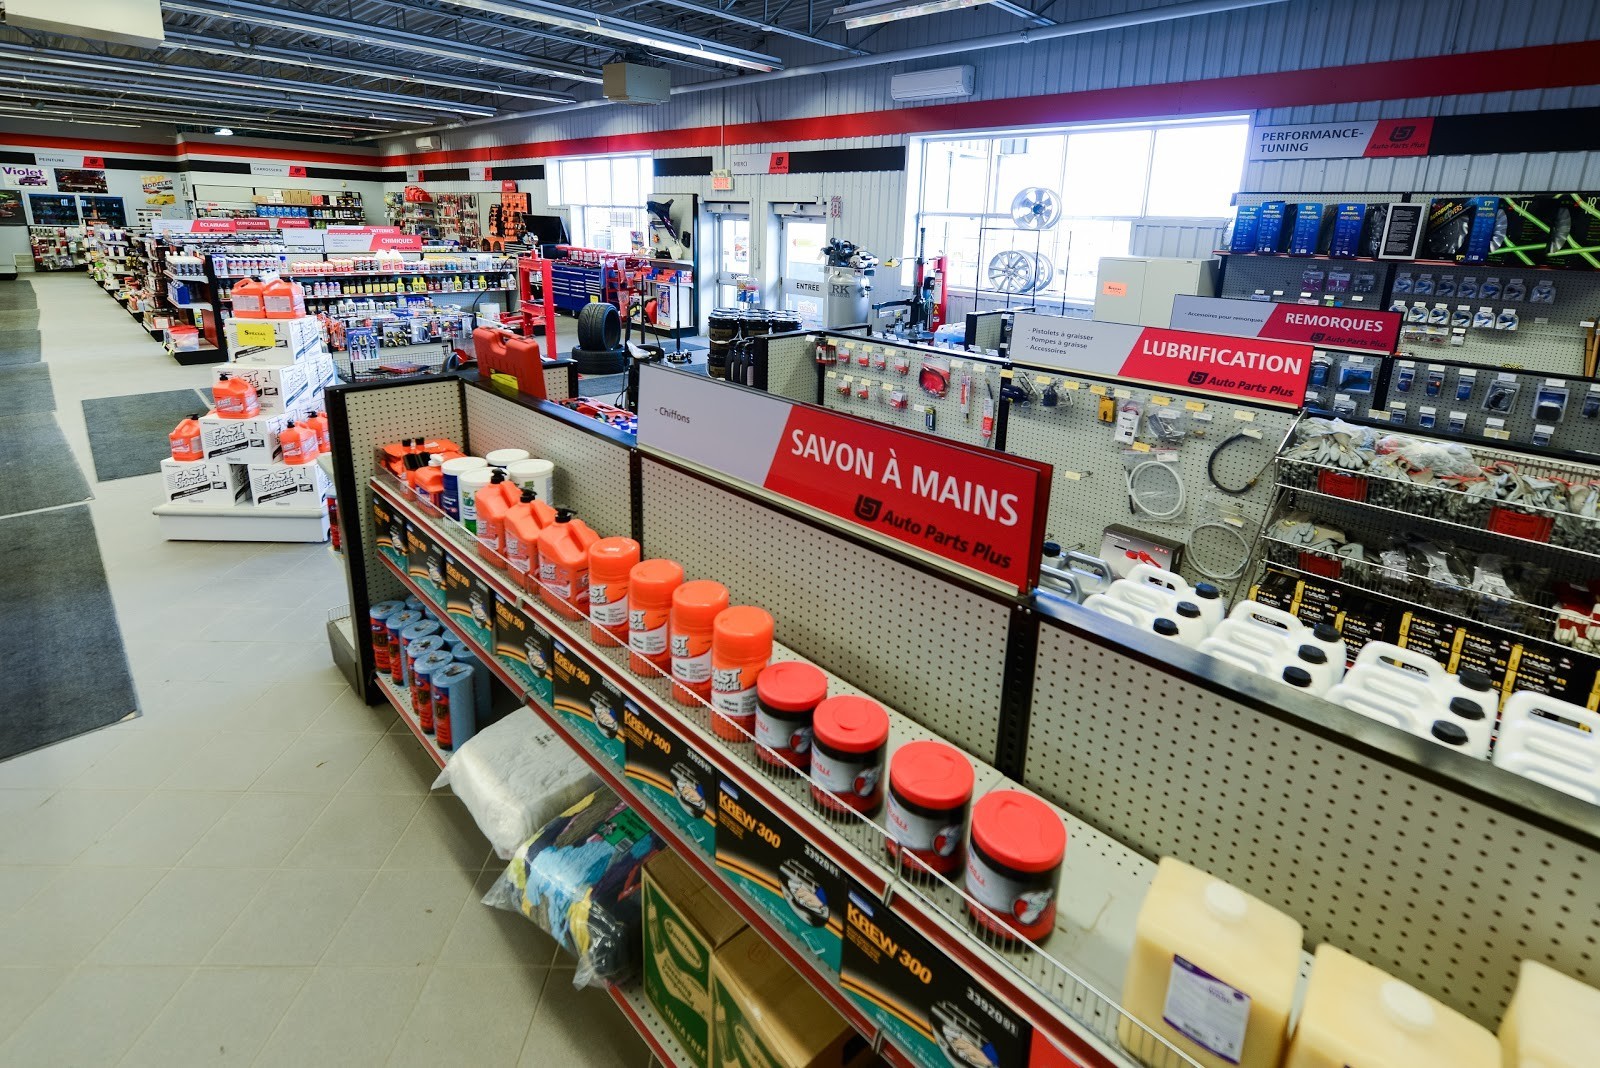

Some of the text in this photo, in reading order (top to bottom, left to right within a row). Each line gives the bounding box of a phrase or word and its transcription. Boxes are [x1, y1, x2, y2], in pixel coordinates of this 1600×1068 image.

[1262, 128, 1364, 142] PERFORMANCE-
[1260, 142, 1309, 152] TUNING
[2, 166, 44, 177] Violet
[141, 174, 165, 184] TOP
[796, 282, 820, 292] ENTRÉE
[832, 285, 850, 294] RK
[1285, 312, 1384, 332] REMORQUES
[1032, 328, 1060, 337] Pistolets
[1066, 333, 1094, 342] graisser
[1030, 344, 1066, 355] Accessoires
[1031, 336, 1056, 346] Pompes
[1064, 341, 1088, 350] graisse
[1346, 338, 1367, 346] Parts
[1370, 340, 1386, 348] Plus
[1142, 340, 1302, 375] LUBRIFICATION
[1208, 377, 1294, 397] Auto Parts Plus
[660, 406, 690, 424] Chiffons
[212, 422, 244, 439] FAST
[212, 432, 246, 446] ORANGE
[174, 464, 206, 482] FAST
[261, 467, 294, 484] FAST
[792, 429, 1018, 526] SAVON À MAINS
[176, 475, 208, 489] ORANGE
[262, 478, 294, 492] ORANGE
[882, 510, 1012, 570] Auto Parts Plus
[1304, 590, 1330, 601] RAVEN
[495, 601, 526, 631] KREW 300
[1344, 623, 1370, 635] RAVEN
[1412, 623, 1440, 636] RAVEN
[1408, 644, 1436, 656] RAVEN
[1466, 640, 1496, 654] RAVEN
[553, 648, 590, 685] KREW 300
[1522, 657, 1556, 672] RAVEN
[712, 667, 742, 686] AST
[1517, 679, 1550, 694] RAVEN
[624, 710, 672, 755] KREW 300
[719, 790, 781, 848] KREW 300
[847, 904, 898, 958] KREW
[899, 950, 932, 985] 300
